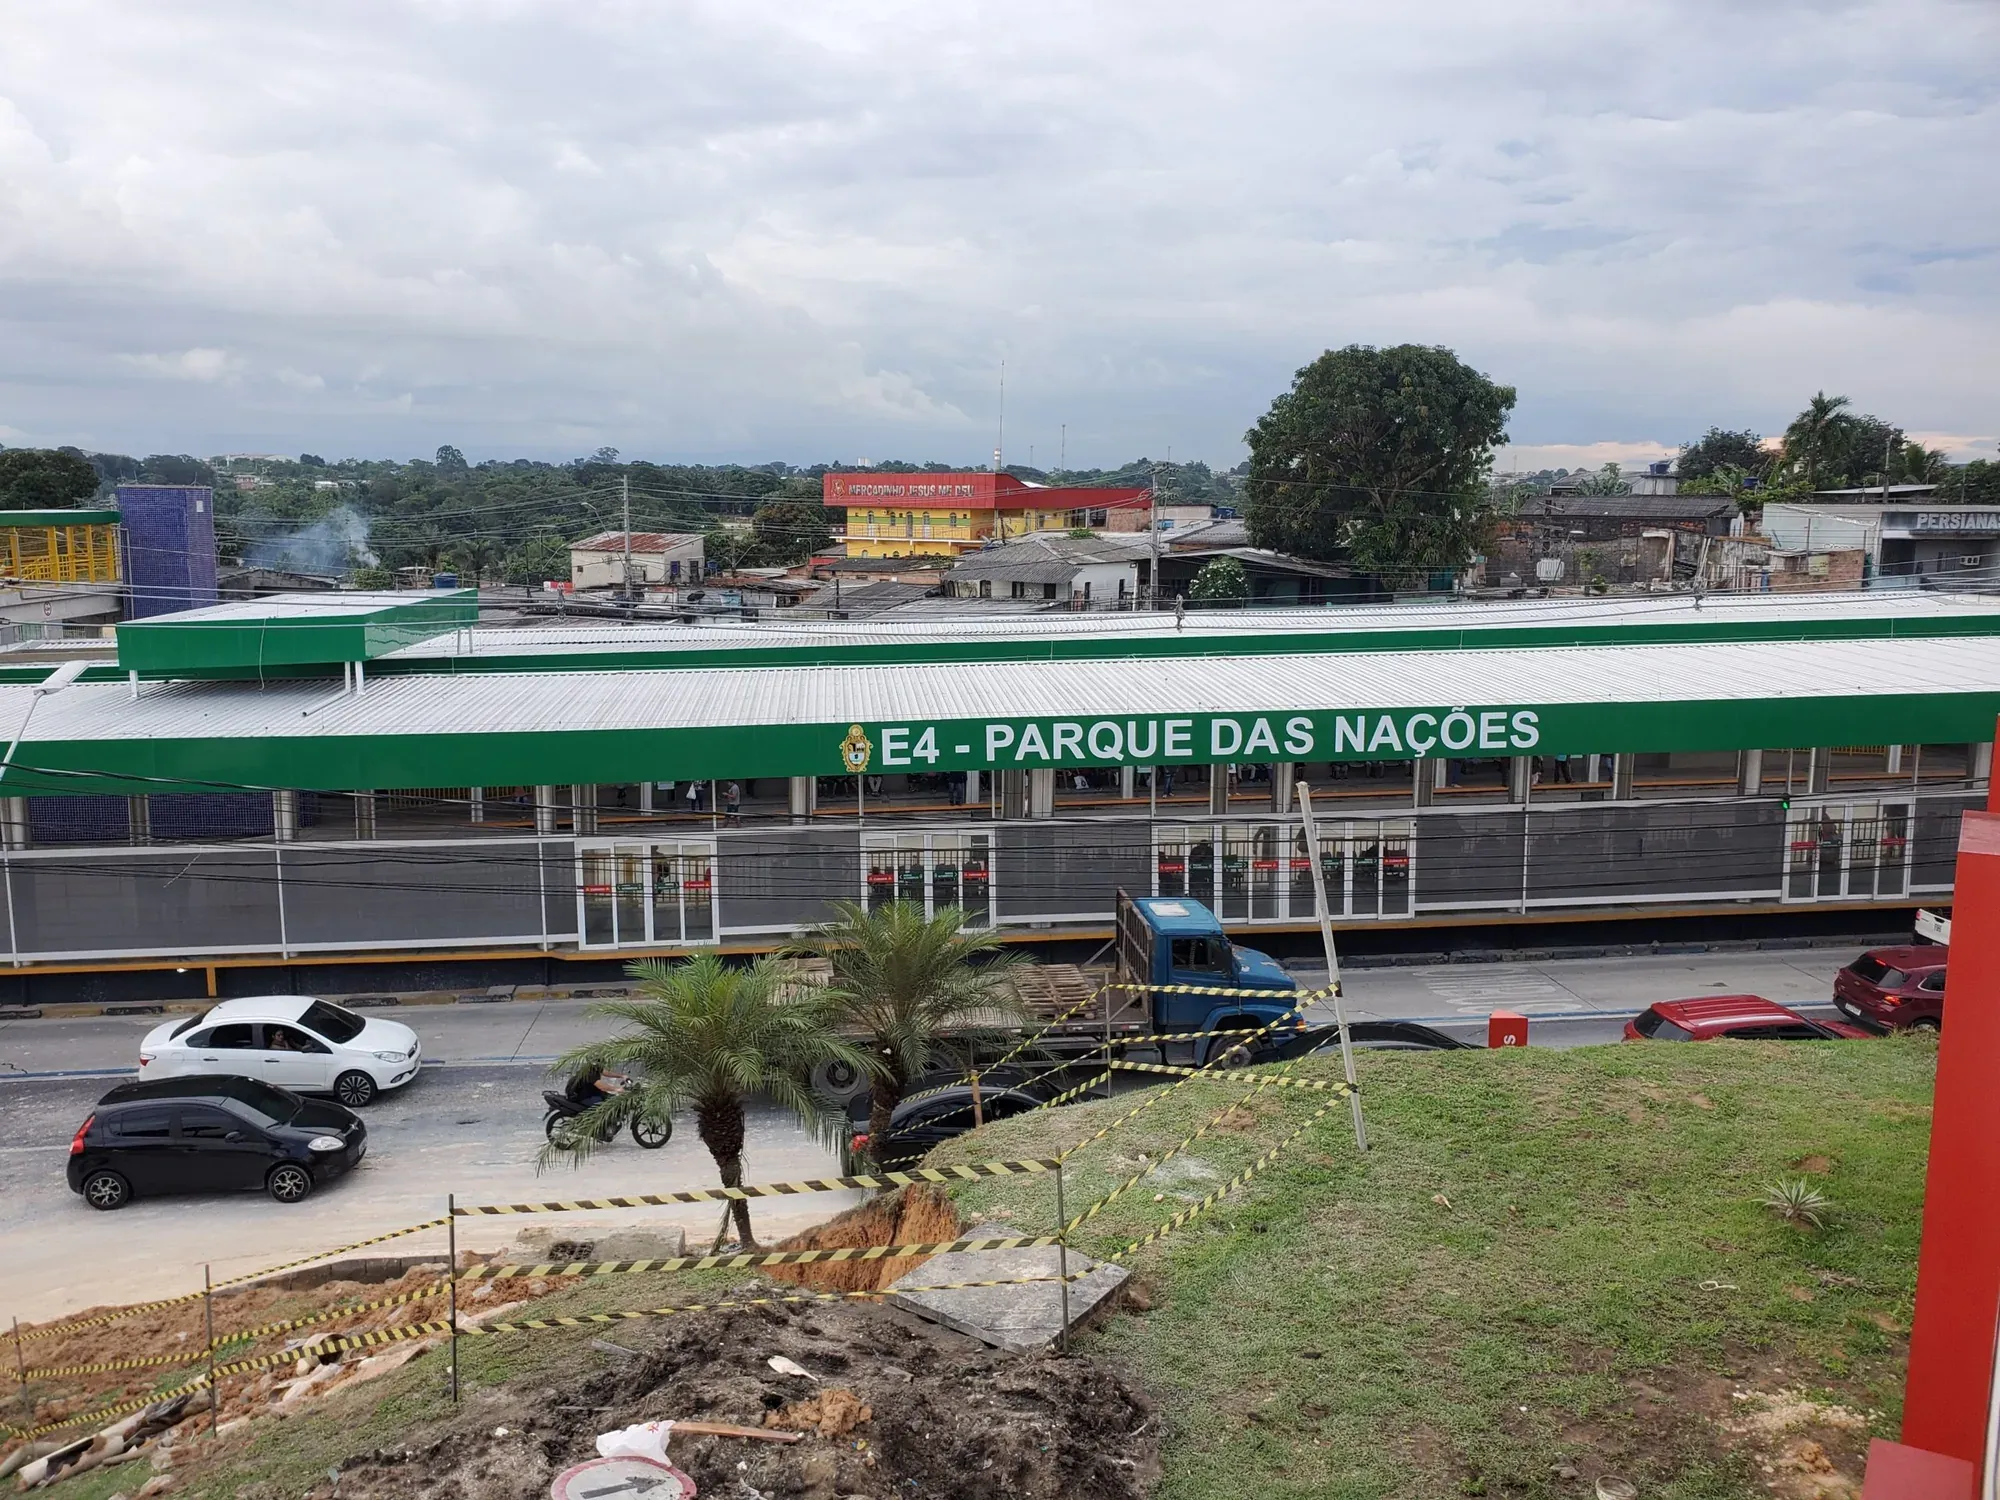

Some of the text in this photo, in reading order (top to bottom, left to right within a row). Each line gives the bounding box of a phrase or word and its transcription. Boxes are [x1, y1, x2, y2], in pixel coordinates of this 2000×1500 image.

[848, 484, 975, 497] MERCADINHO JESUS ME DEU
[1916, 513, 2000, 529] PERSIANA
[881, 726, 940, 766] E4
[985, 719, 1193, 762] PARQUE
[1211, 716, 1314, 756] DAS
[1334, 705, 1540, 758] NAÇÕES
